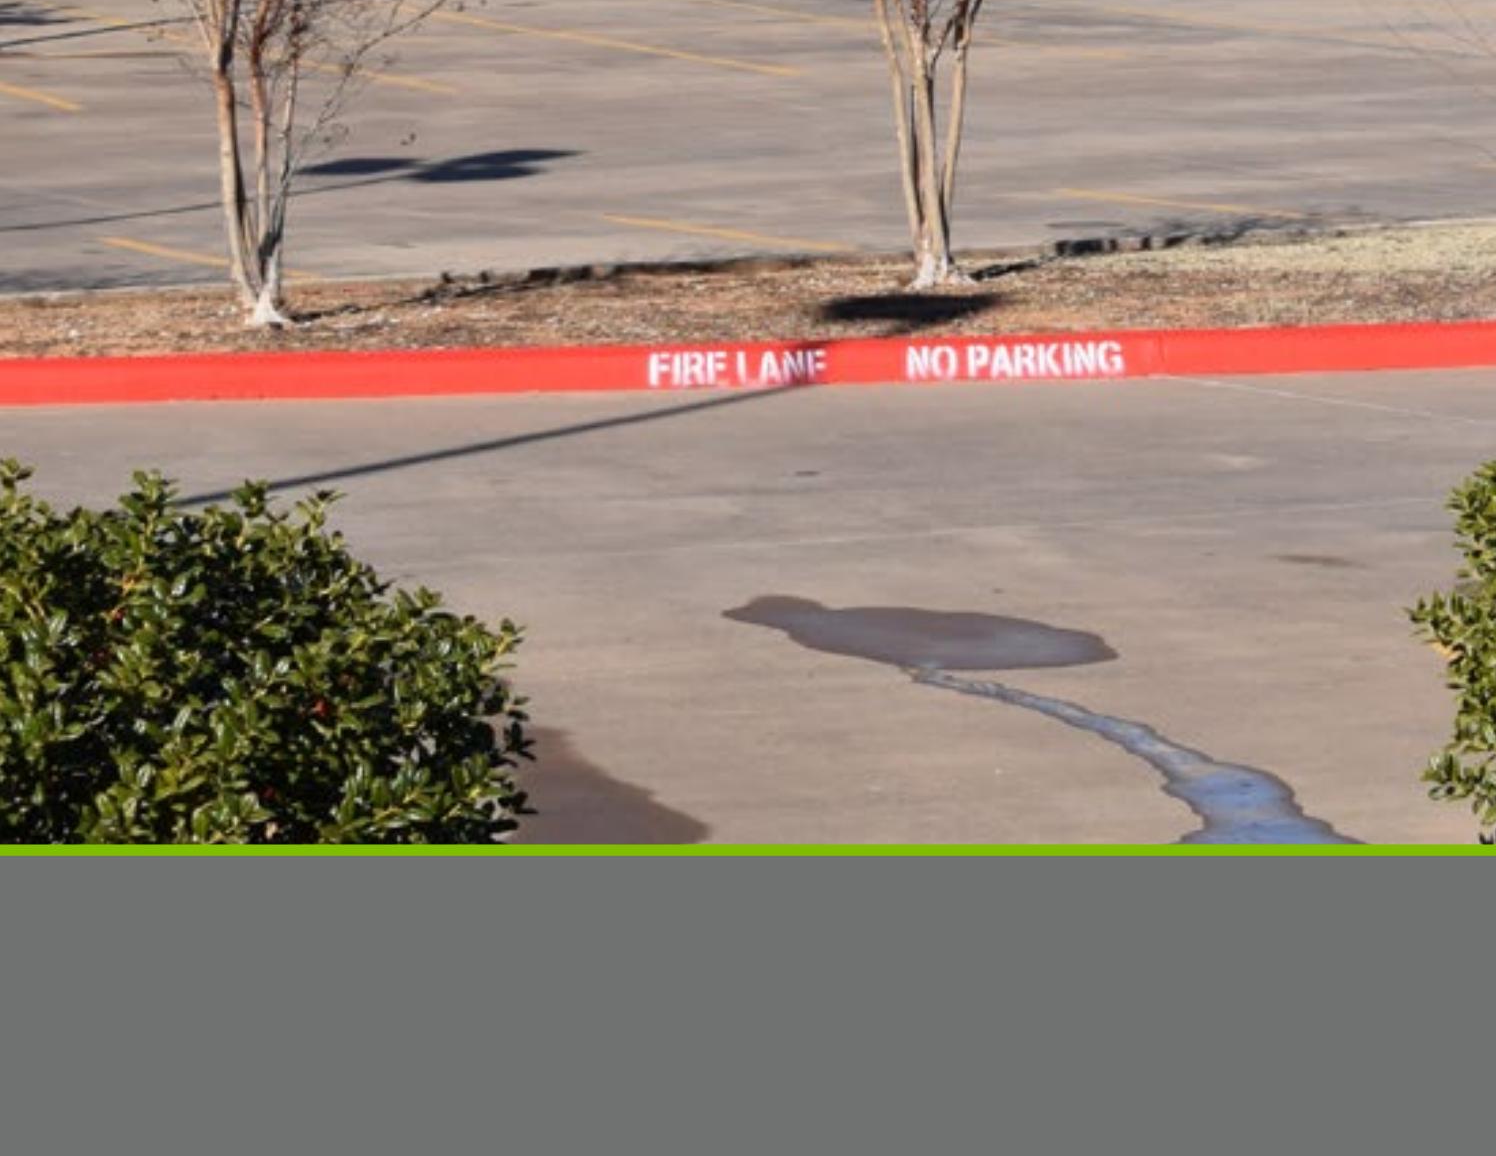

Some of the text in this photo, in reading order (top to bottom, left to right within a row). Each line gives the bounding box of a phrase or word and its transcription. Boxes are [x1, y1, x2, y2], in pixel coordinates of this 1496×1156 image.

[649, 348, 828, 387] FIRE LANE
[906, 341, 1126, 380] NO PARKING
